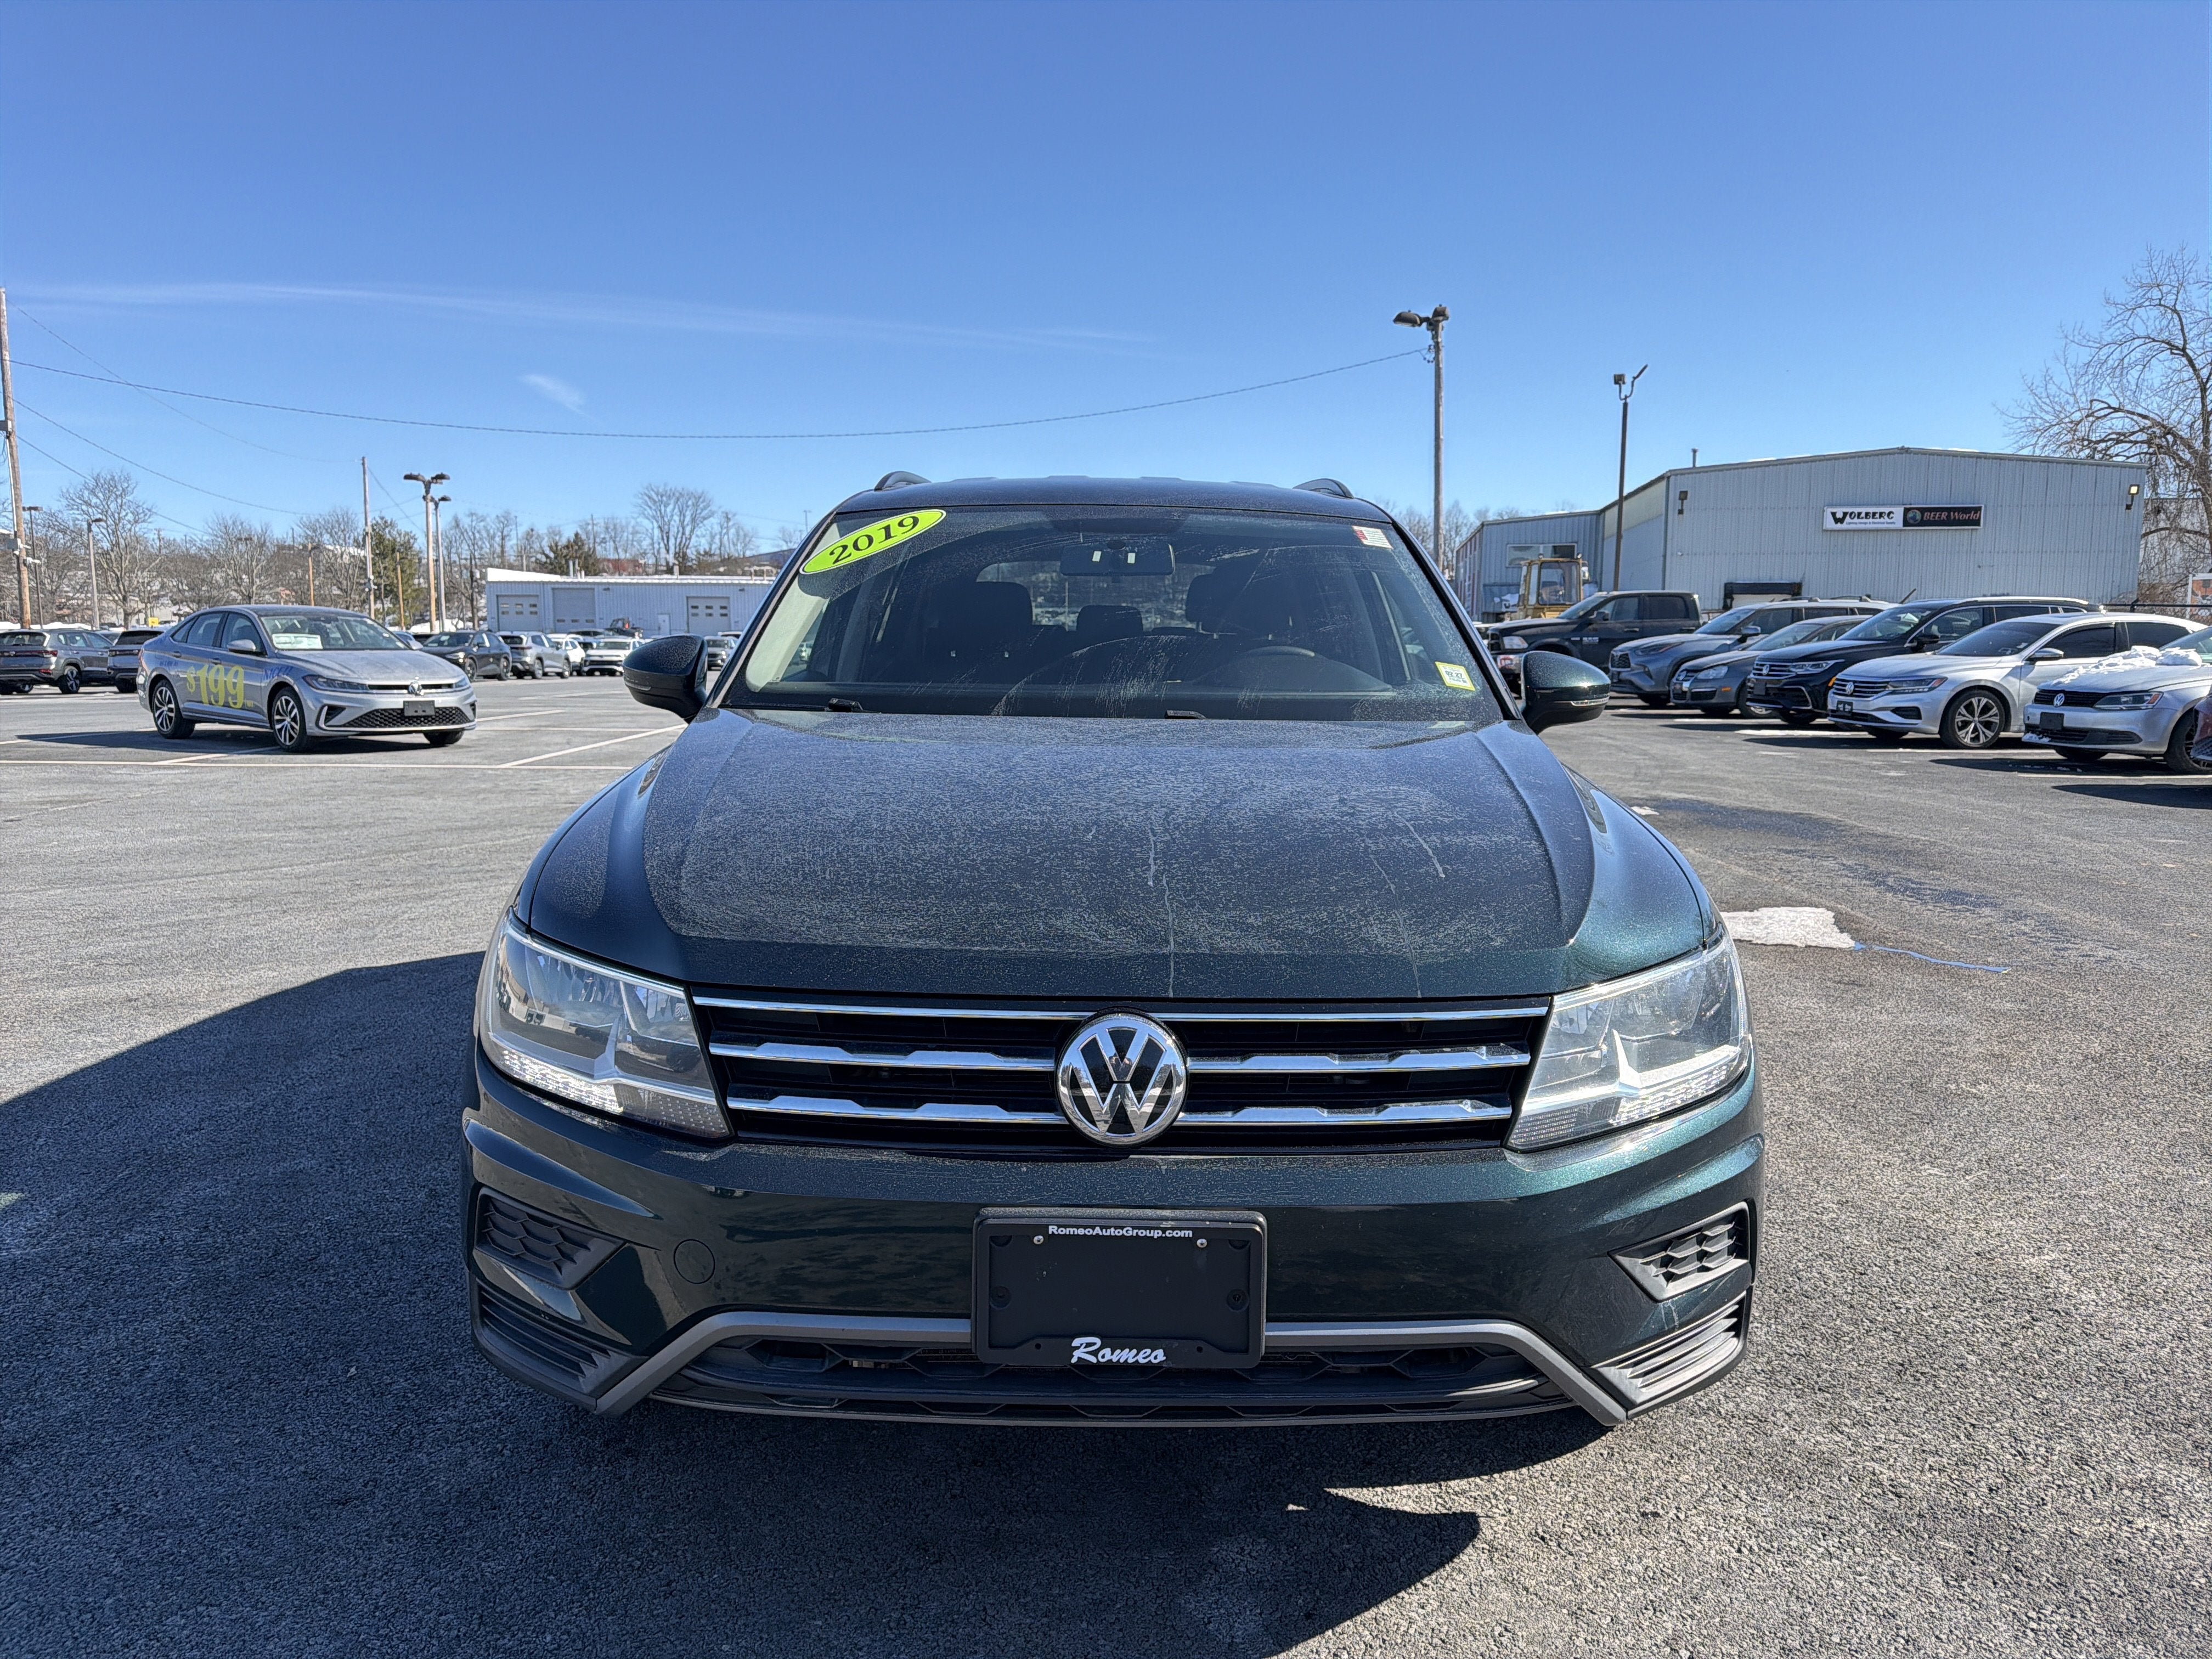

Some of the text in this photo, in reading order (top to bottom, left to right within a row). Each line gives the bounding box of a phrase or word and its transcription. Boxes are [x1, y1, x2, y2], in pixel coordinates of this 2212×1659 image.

[1923, 511, 1980, 521] BEER World
[829, 516, 919, 565] 2019
[187, 664, 244, 709] $199
[1059, 1014, 1186, 1146] VW
[1048, 1226, 1193, 1238] RomeoAutoGroup.com
[1071, 1337, 1166, 1363] Romeo
